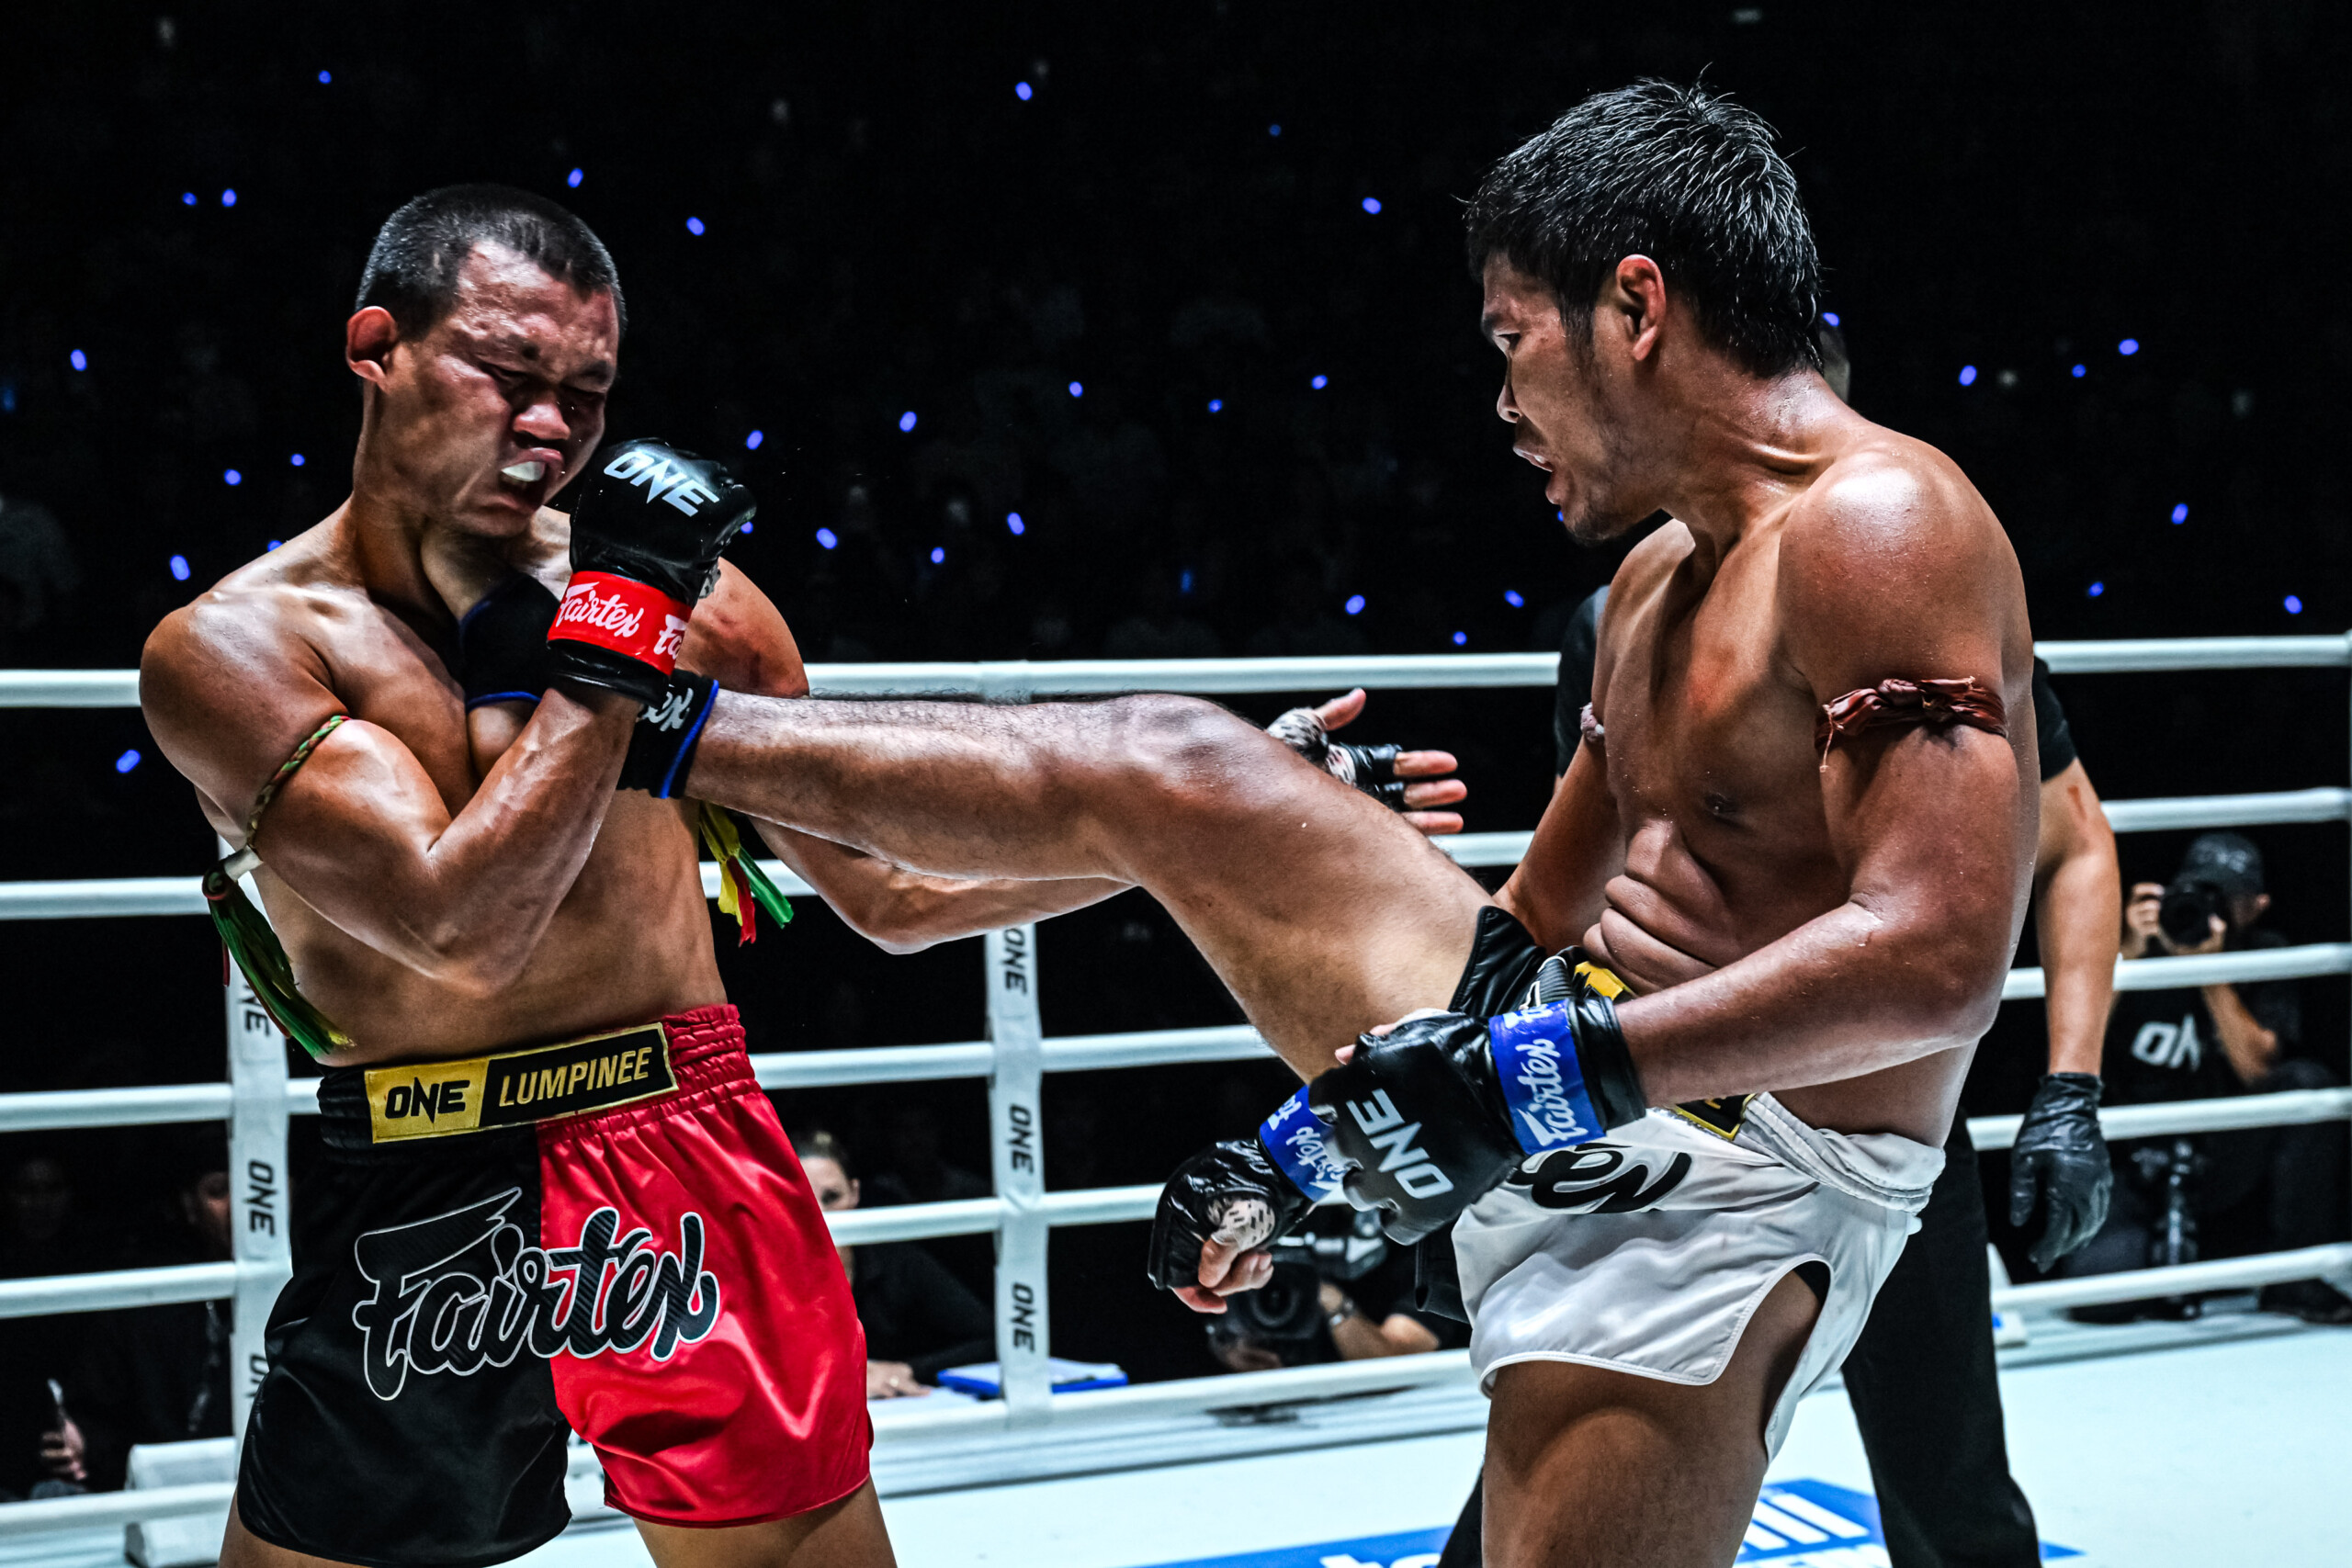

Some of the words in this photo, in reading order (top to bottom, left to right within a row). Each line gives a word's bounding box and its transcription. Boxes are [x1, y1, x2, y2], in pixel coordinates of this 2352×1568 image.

[603, 451, 720, 517] ONE
[555, 581, 644, 637] Fairtex
[1000, 928, 1028, 995] ONE
[384, 1077, 470, 1124] ONE
[499, 1046, 652, 1107] LUMPINEE
[1515, 1038, 1589, 1147] Fairtex
[1004, 1103, 1035, 1175] ONE
[1345, 1088, 1454, 1200] ONE
[243, 1159, 278, 1237] ONE
[352, 1187, 721, 1402] Fairtex
[1008, 1282, 1039, 1353] ONE
